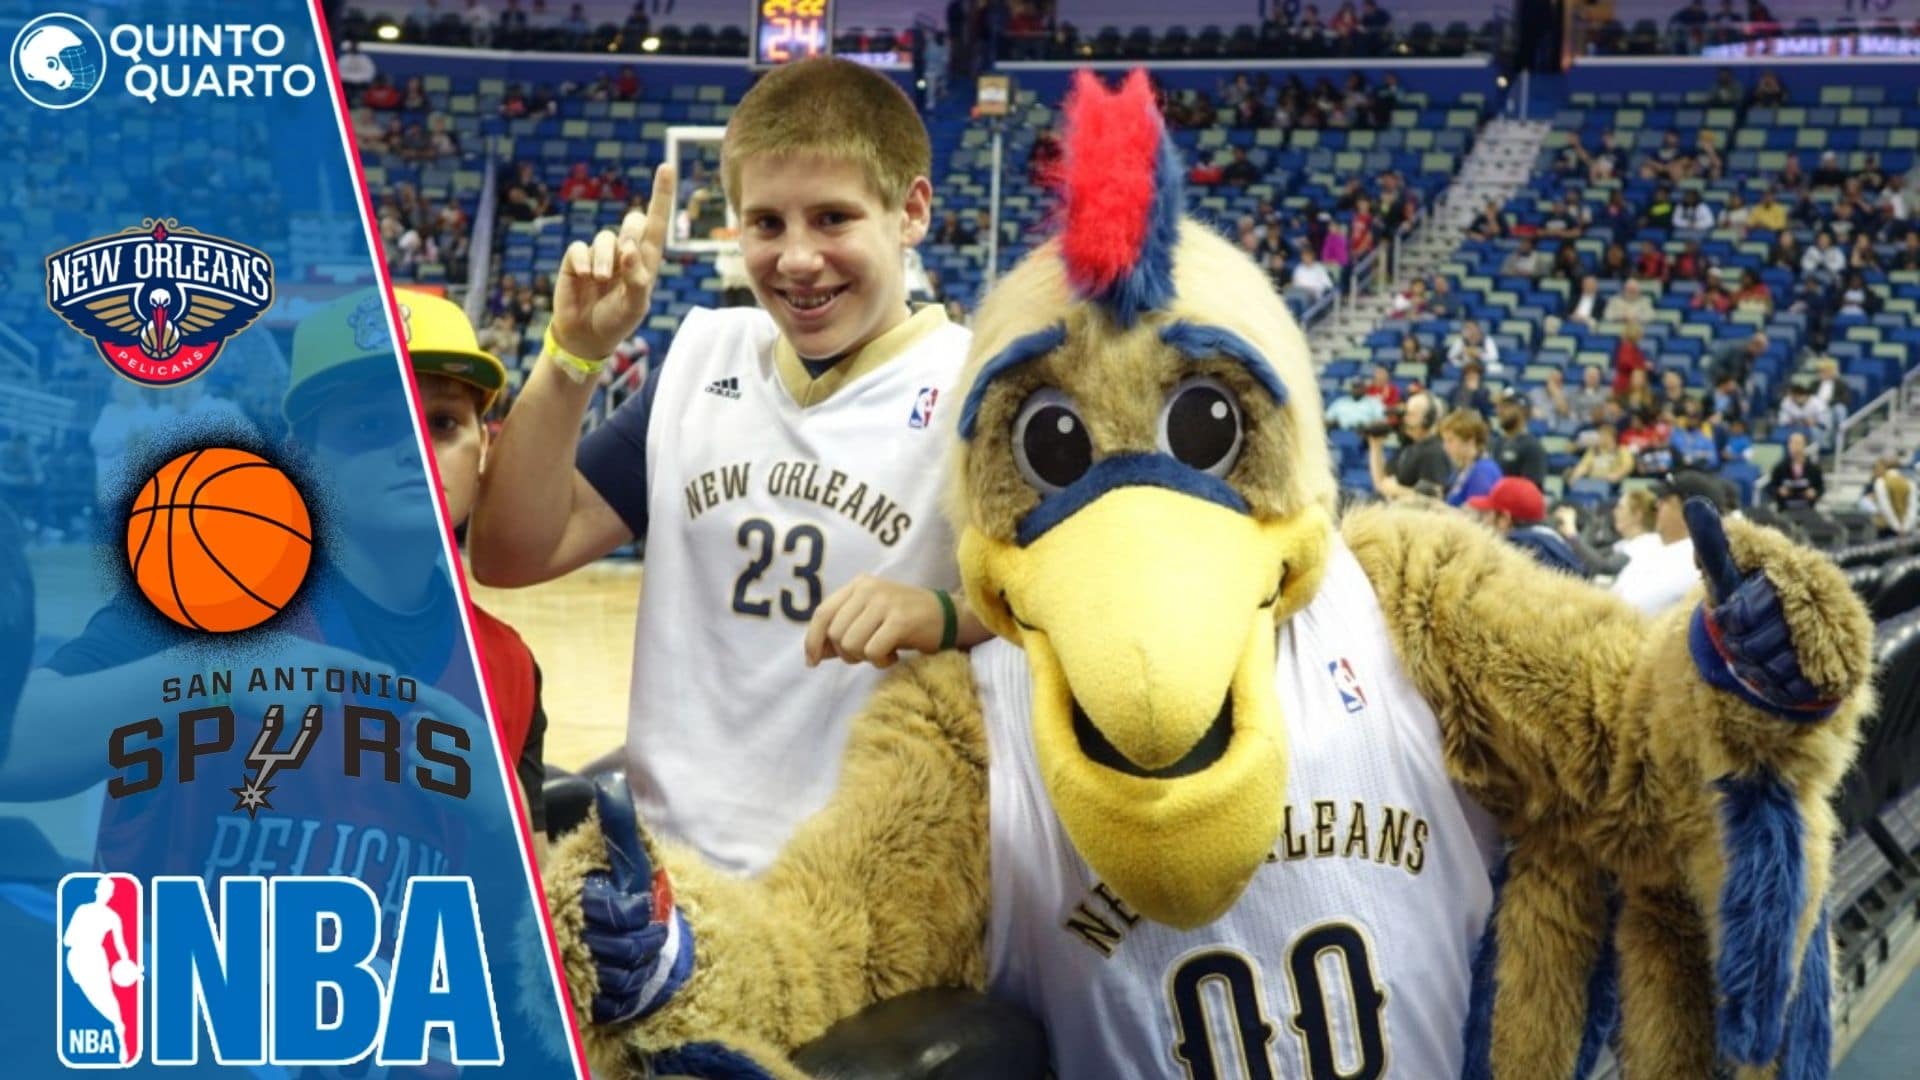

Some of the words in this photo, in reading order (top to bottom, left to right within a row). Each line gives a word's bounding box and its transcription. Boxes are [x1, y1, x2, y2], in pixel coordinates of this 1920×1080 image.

[767, 17, 819, 61] 24
[684, 462, 750, 520] NEW
[767, 461, 912, 548] ORLEANS
[732, 517, 824, 623] 23
[1266, 801, 1429, 875] LEANS
[1063, 881, 1141, 960] NE
[1165, 917, 1389, 1080] 00
